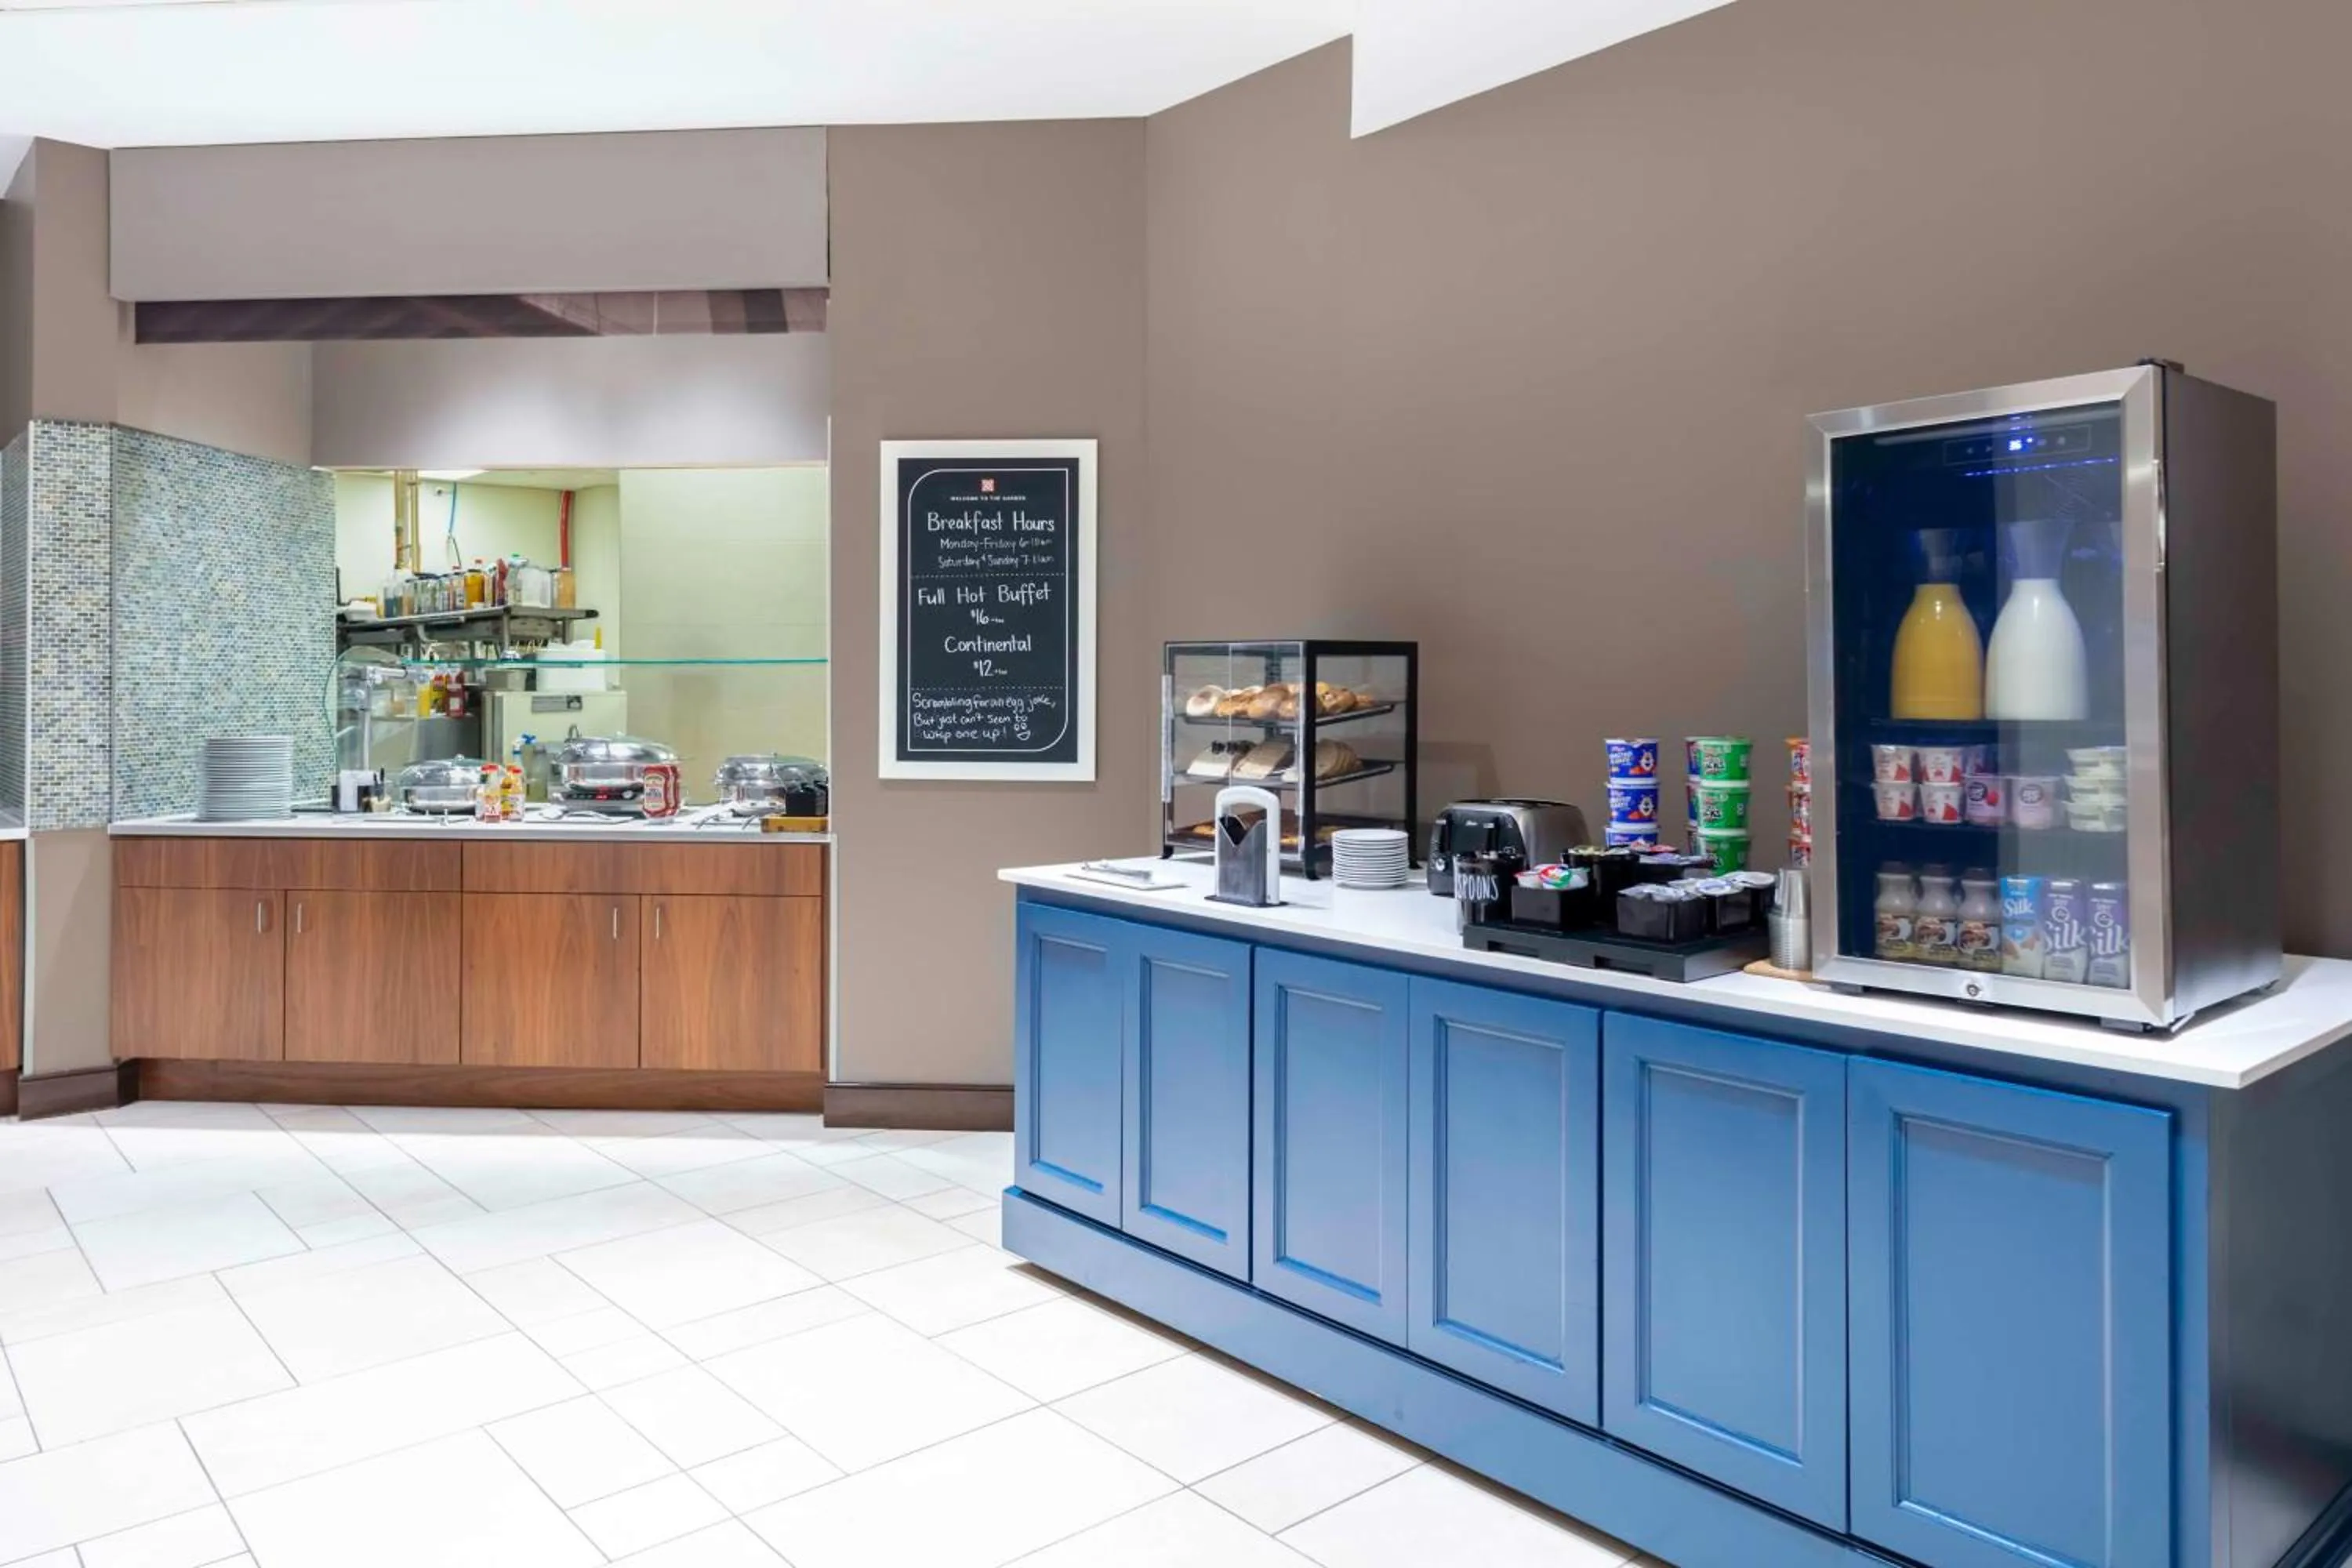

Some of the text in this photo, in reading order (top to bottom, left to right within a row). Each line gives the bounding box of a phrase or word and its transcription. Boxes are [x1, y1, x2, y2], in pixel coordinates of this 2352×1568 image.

[927, 510, 1055, 535] Breakfast Hours
[918, 582, 1051, 607] Full Hot Buffet
[944, 633, 1032, 654] Continental
[913, 712, 935, 727] But
[956, 729, 978, 739] one
[1457, 873, 1499, 901] SPOONS
[2004, 898, 2035, 917] Silk
